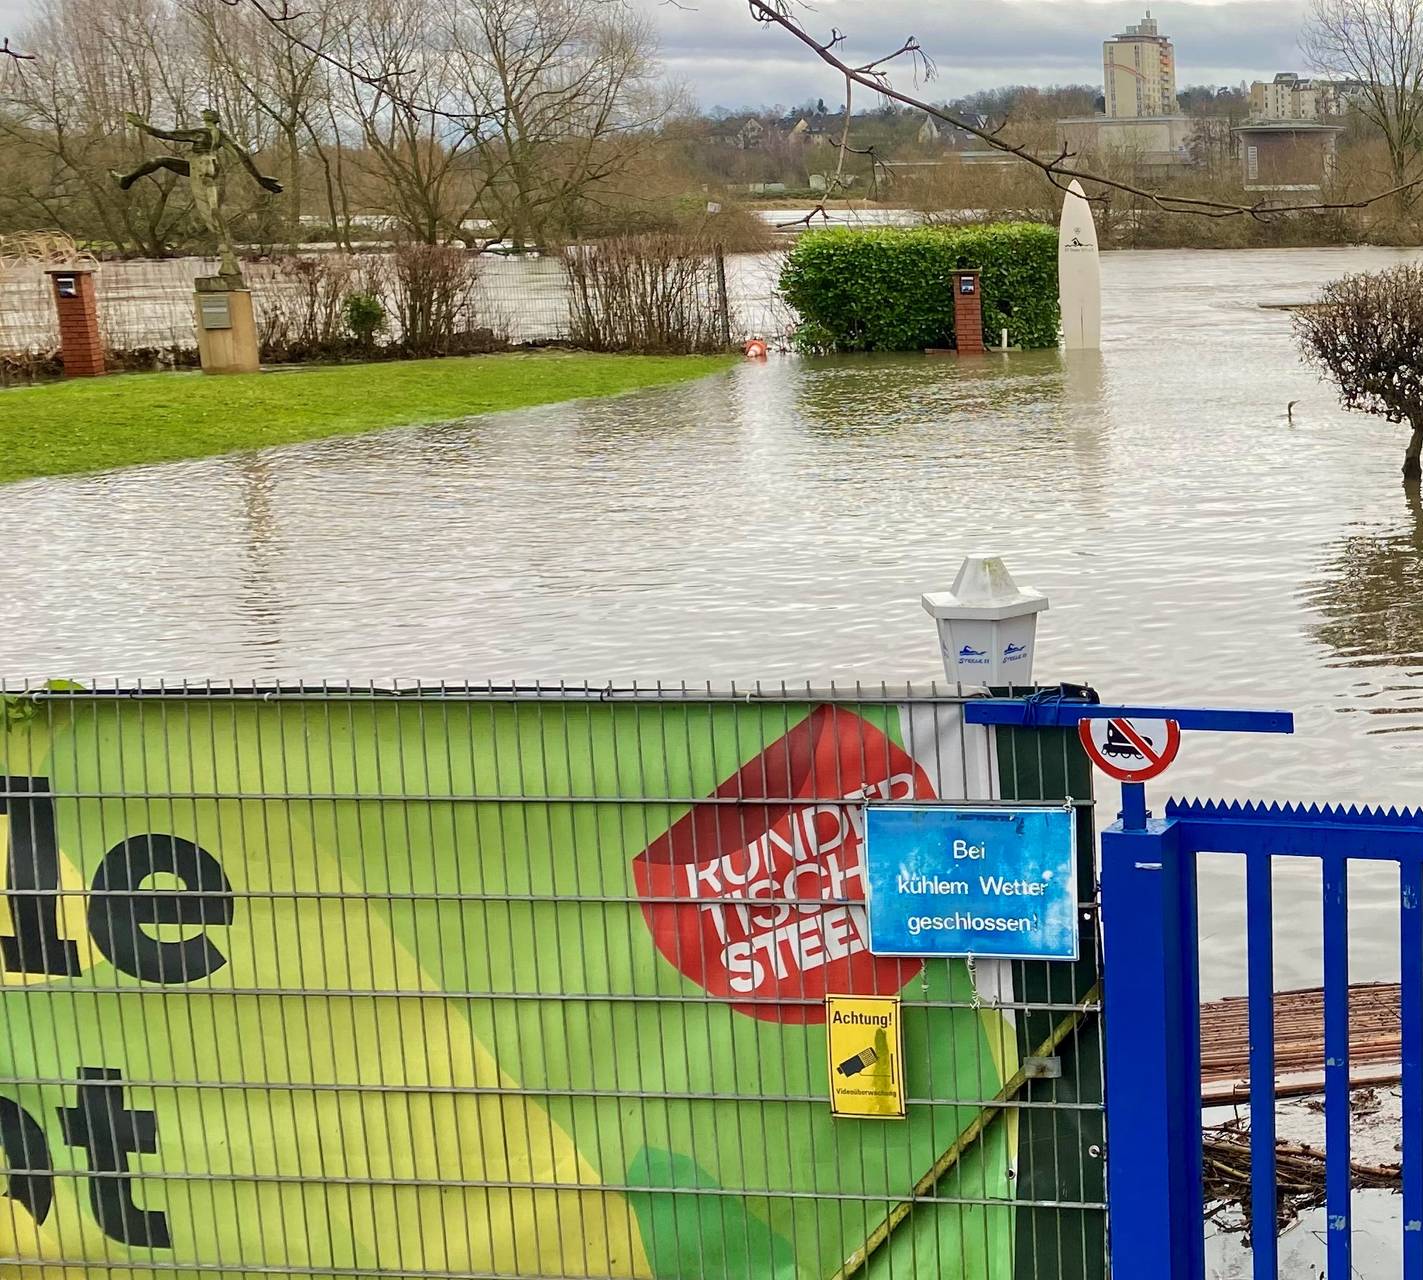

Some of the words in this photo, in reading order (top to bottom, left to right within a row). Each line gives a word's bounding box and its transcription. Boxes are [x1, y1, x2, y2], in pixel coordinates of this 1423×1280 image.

[953, 839, 985, 860] Bei
[701, 843, 868, 945] TISCH
[898, 875, 969, 895] kühlem
[979, 876, 1049, 896] Wetter
[832, 1010, 893, 1029] Achtung!
